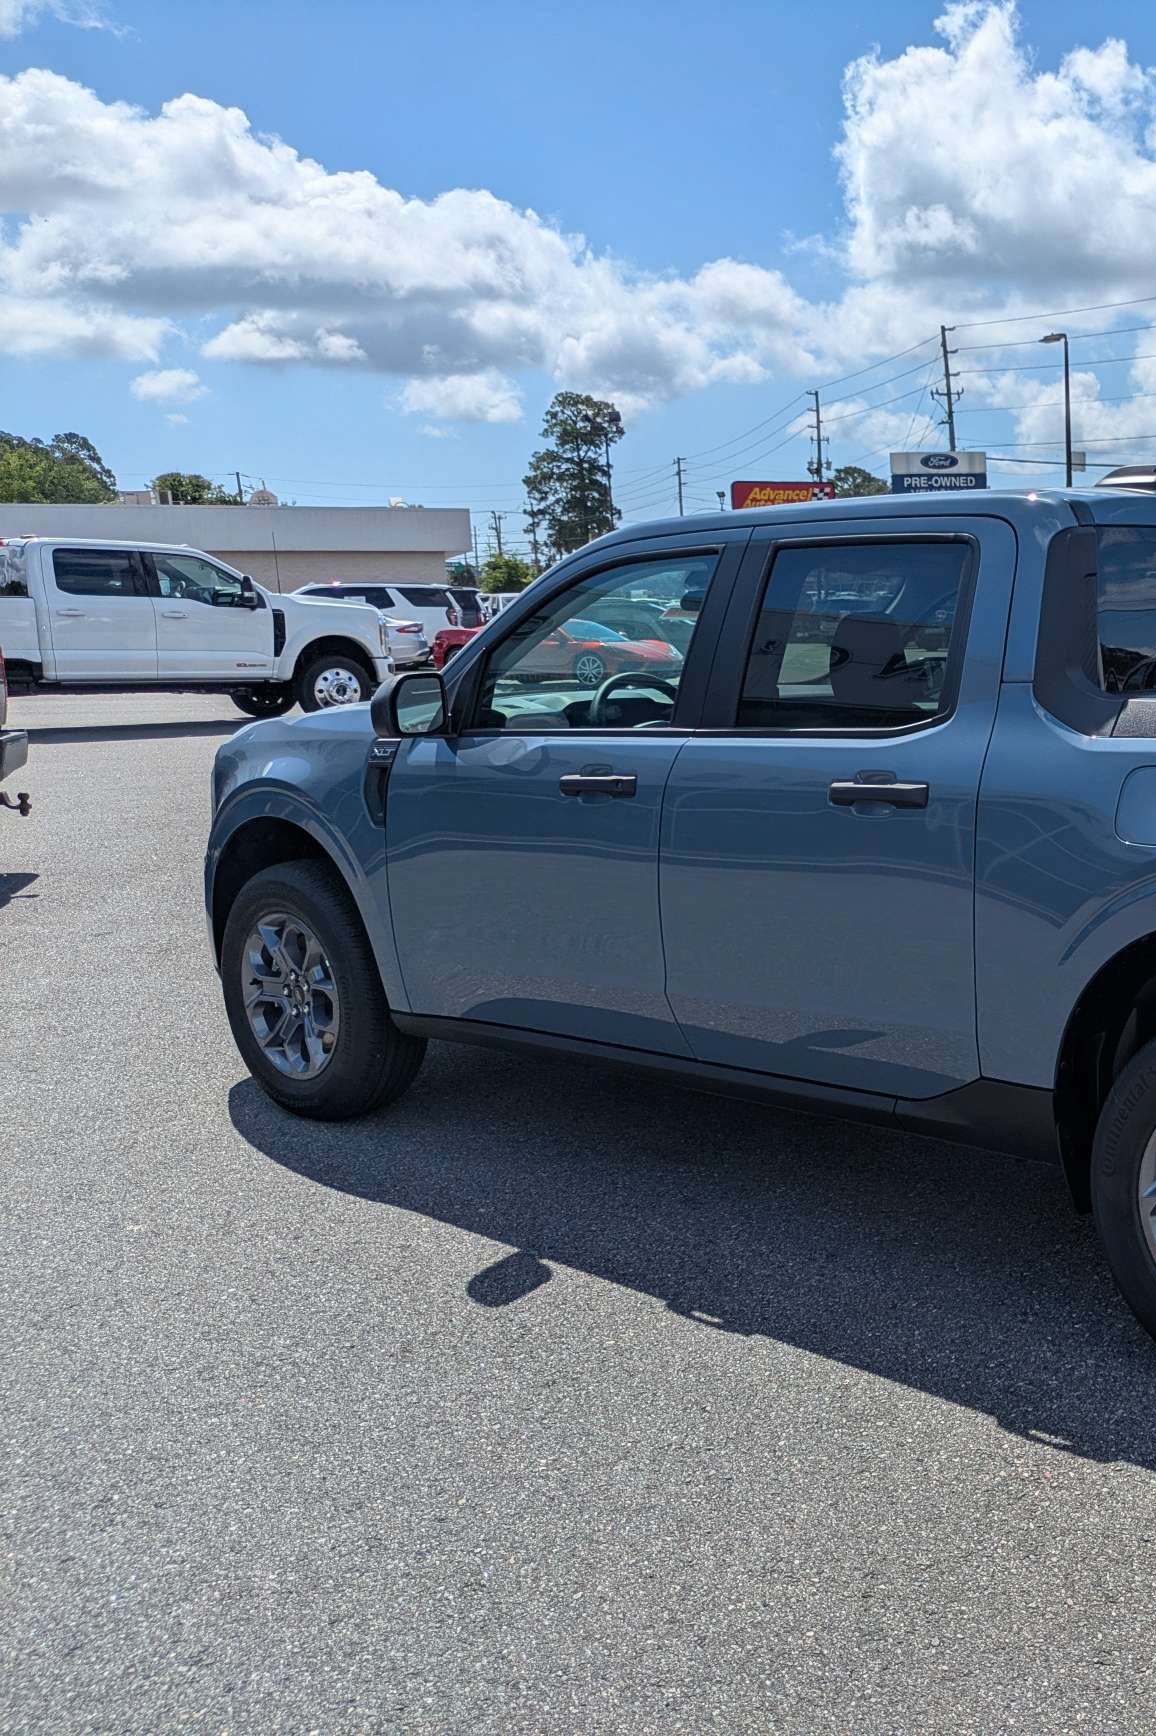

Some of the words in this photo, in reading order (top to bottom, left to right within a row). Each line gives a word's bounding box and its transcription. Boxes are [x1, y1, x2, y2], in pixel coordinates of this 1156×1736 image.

[927, 456, 952, 467] Ford
[903, 476, 976, 488] PRE-OWNED
[371, 746, 396, 757] XLT
